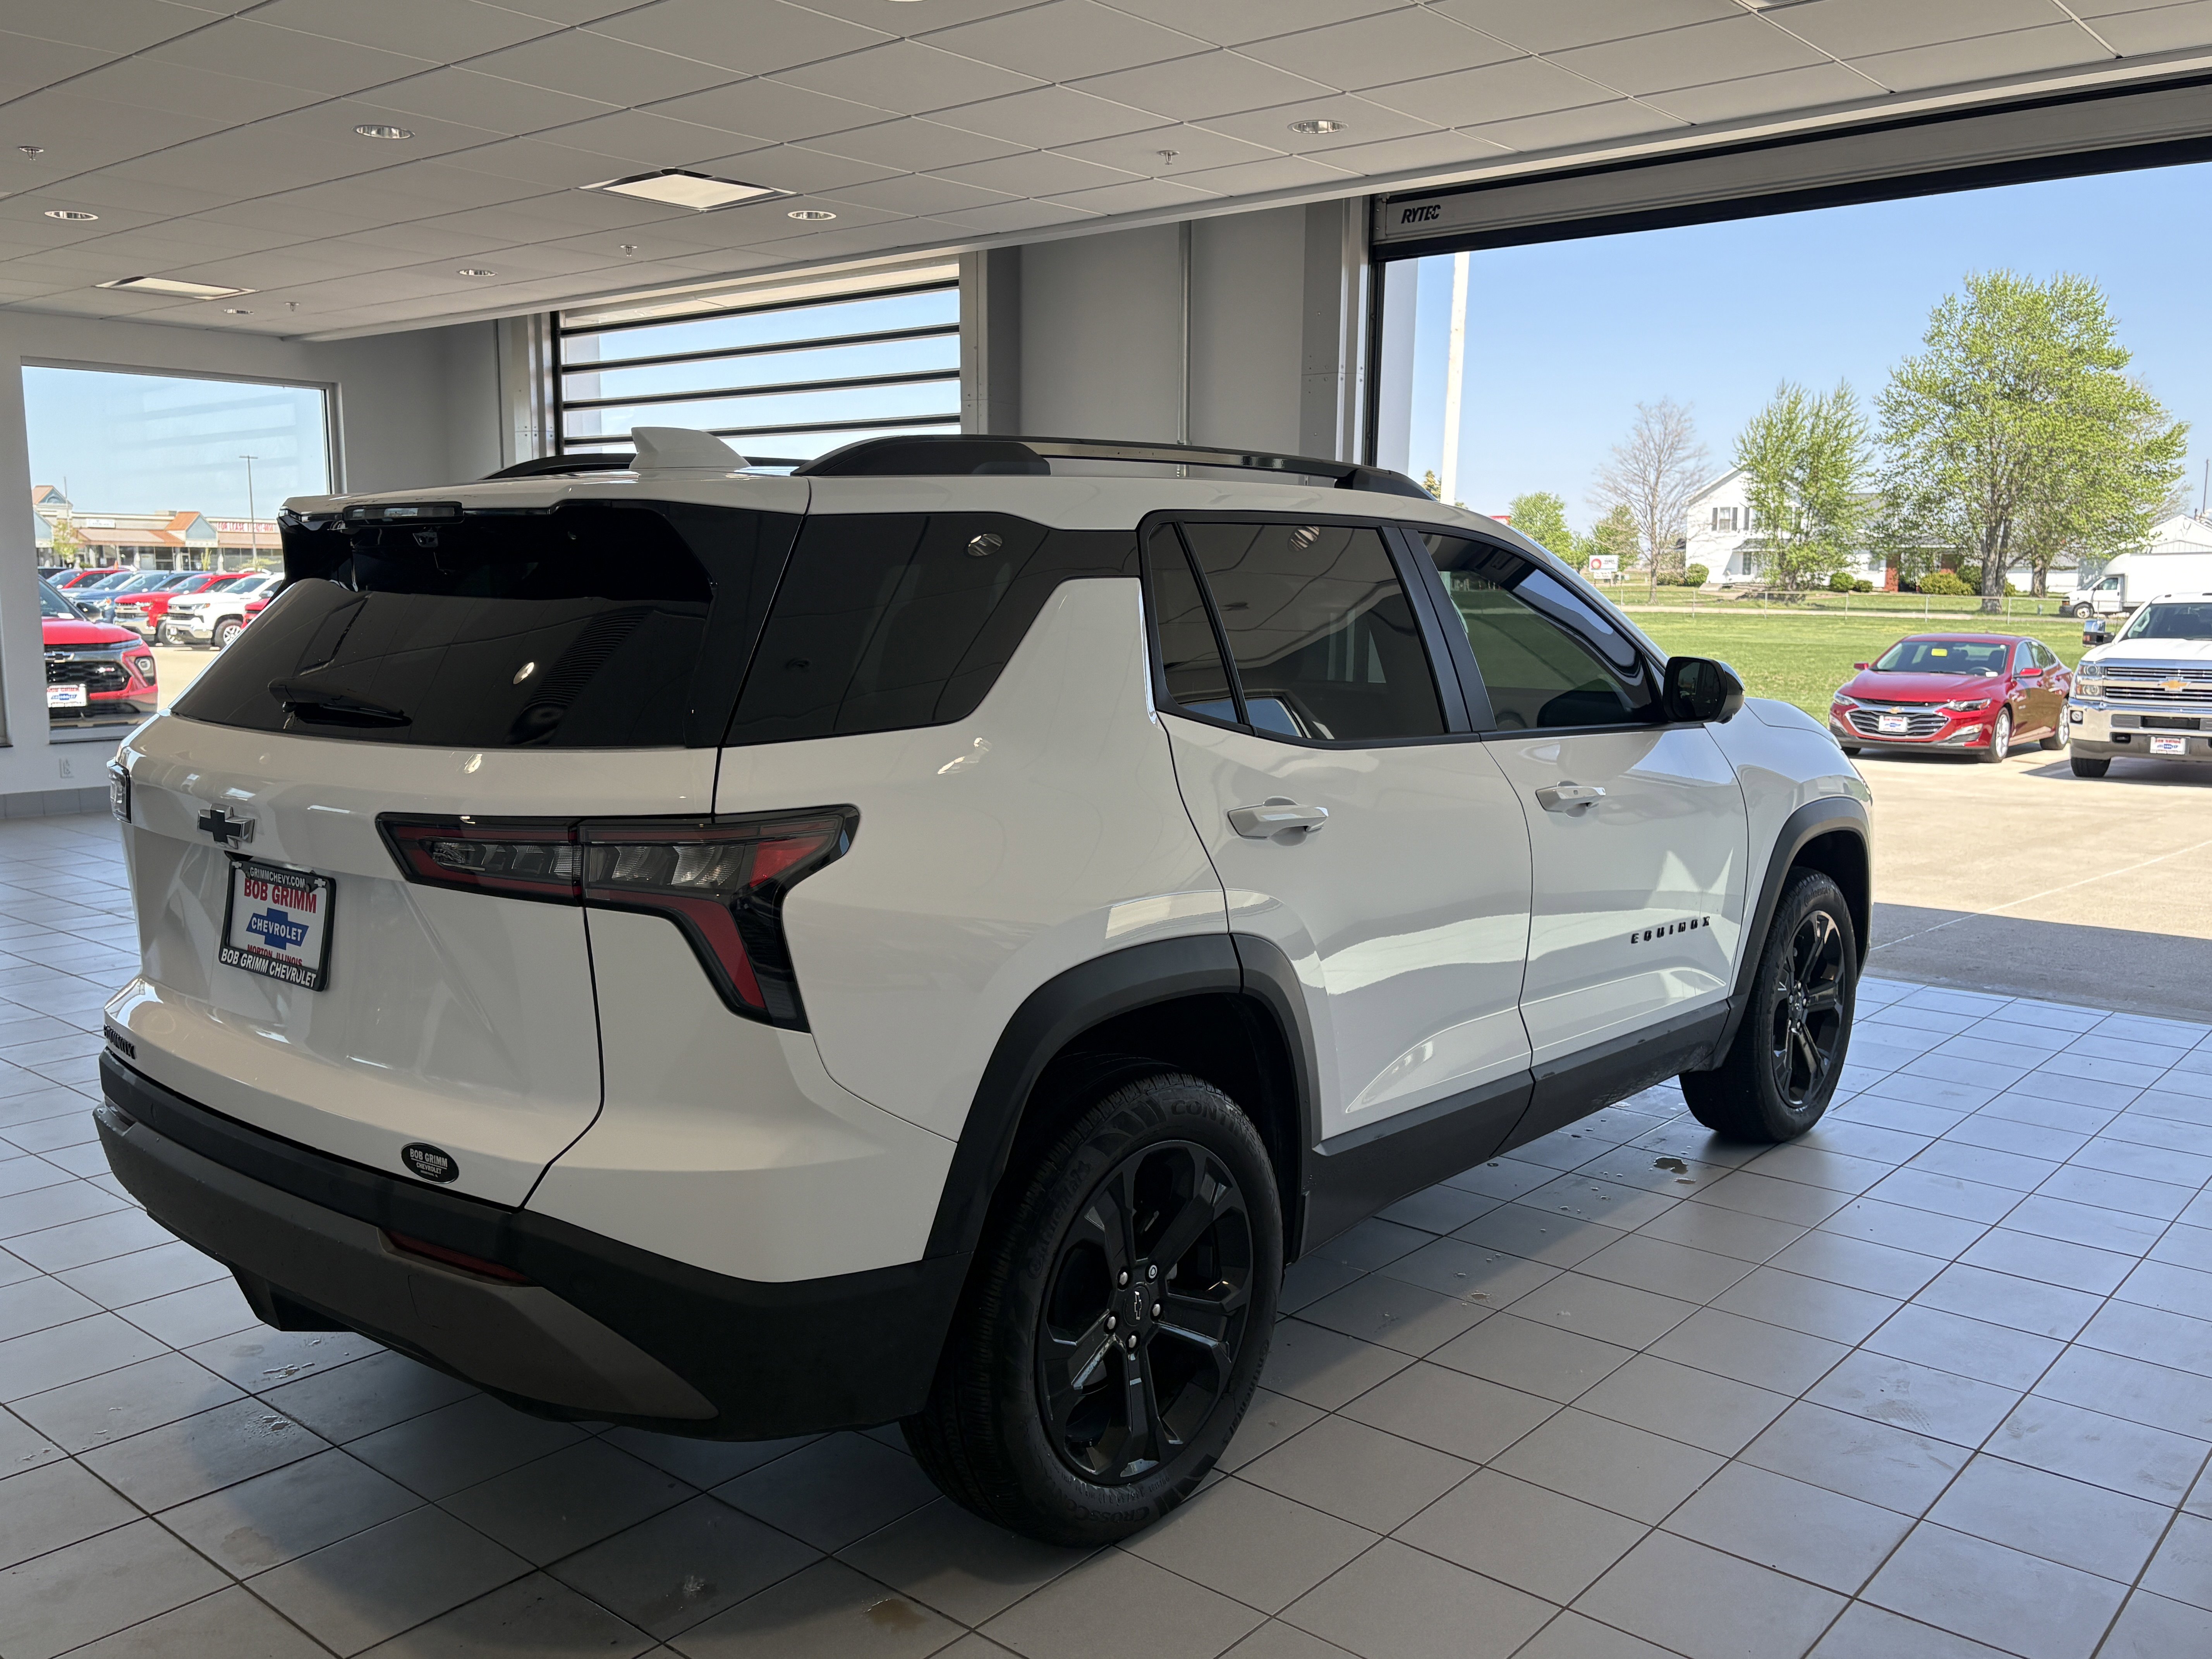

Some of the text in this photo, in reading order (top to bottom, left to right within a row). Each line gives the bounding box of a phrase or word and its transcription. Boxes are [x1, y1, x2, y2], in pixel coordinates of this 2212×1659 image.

[1401, 204, 1441, 224] RYTEC
[250, 867, 305, 888] GRIMMCHEVY.COM
[244, 878, 316, 913] BOB GRIMM
[251, 917, 302, 941] CHEVROLET
[1631, 916, 1710, 944] EQUINOX
[221, 948, 317, 988] BOB GRIMM CHEVROLET
[410, 1148, 448, 1168] BOB GRIMM
[416, 1162, 442, 1174] CHEVROLET
